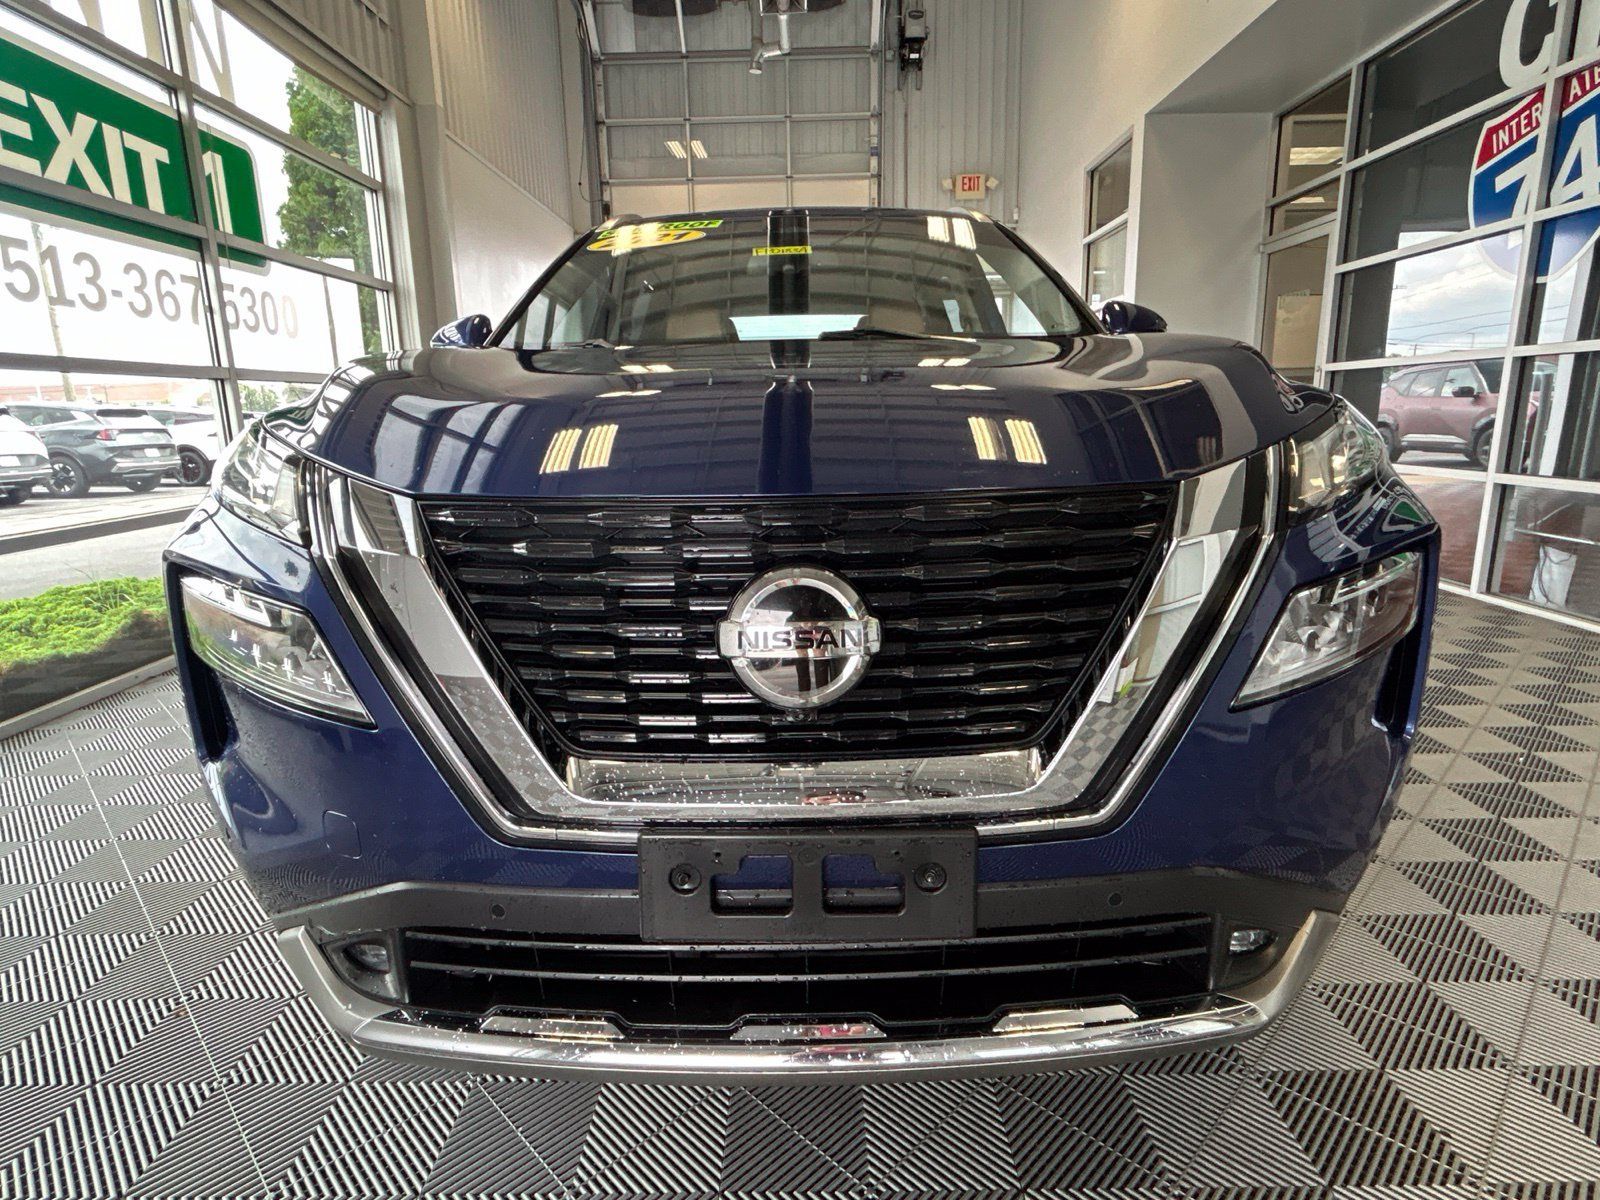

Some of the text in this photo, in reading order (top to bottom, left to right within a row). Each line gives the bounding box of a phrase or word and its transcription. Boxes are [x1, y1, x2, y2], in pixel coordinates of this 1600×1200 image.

[0, 80, 234, 234] EXIT 1
[961, 175, 981, 192] EXIT
[1494, 114, 1600, 250] 74
[737, 628, 863, 650] NISSAN
